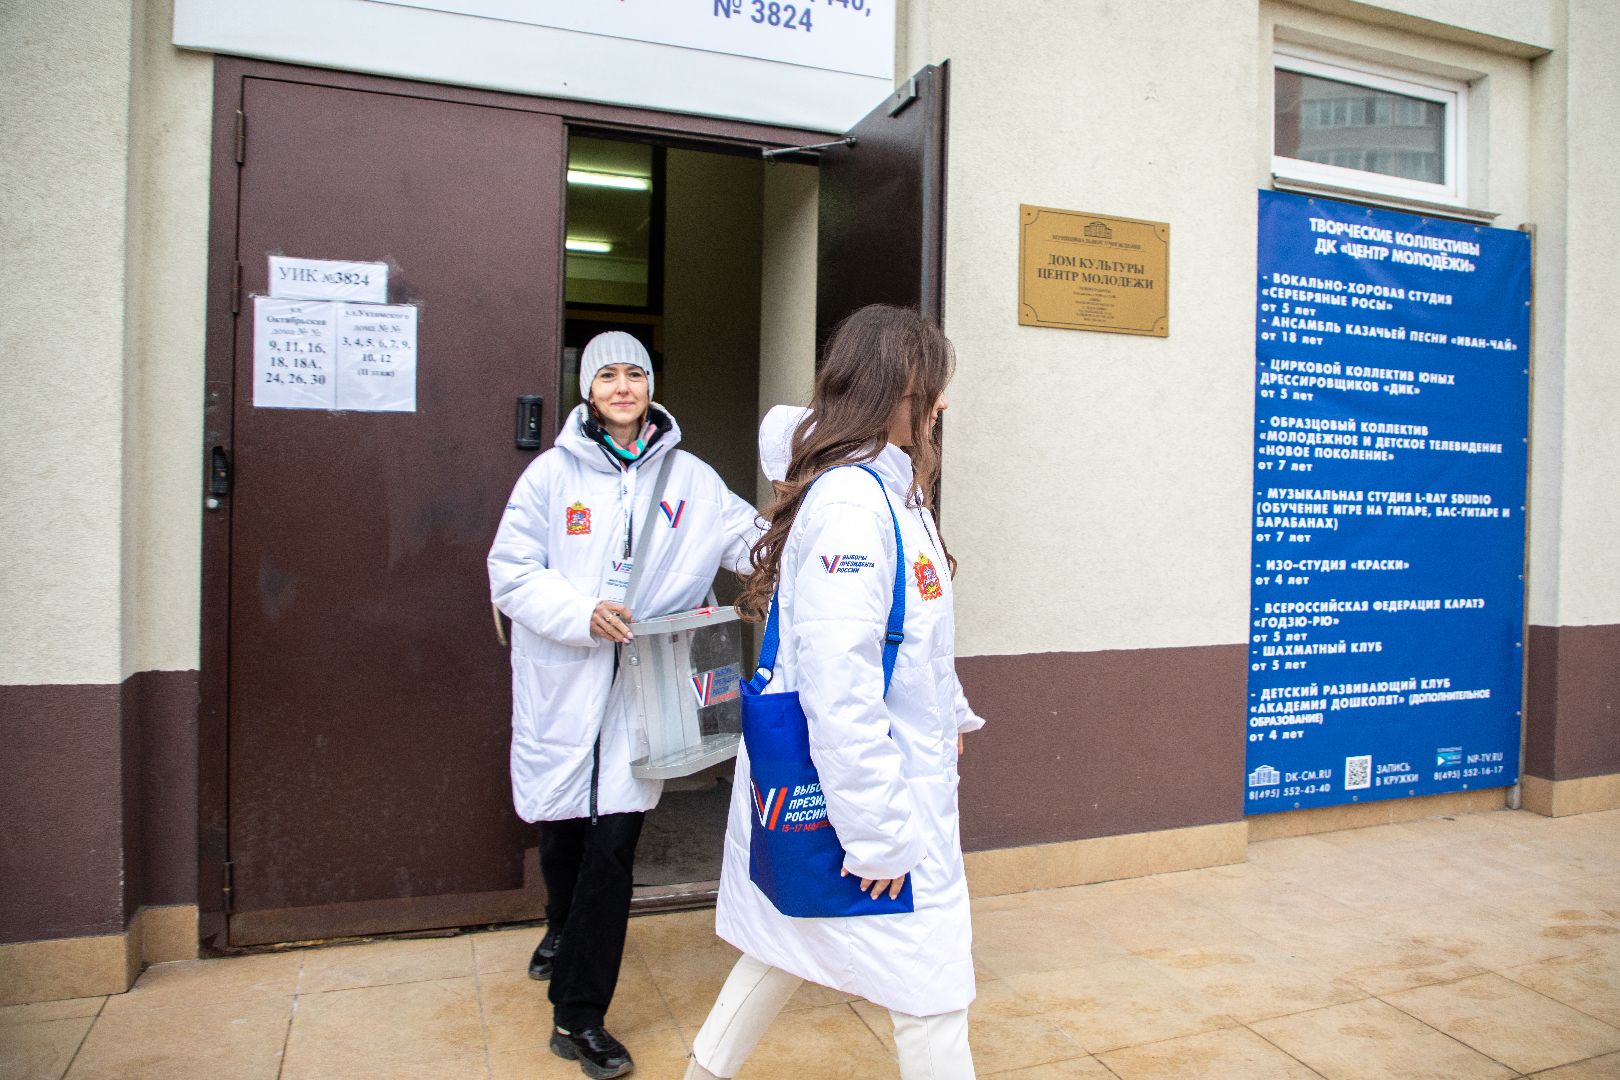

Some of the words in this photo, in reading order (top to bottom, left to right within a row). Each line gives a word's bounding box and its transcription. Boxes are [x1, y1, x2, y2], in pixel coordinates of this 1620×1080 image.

[713, 0, 742, 18] №
[750, 0, 813, 32] 3824
[1309, 217, 1394, 243] ТВОРЧЕСКИЕ
[1395, 231, 1480, 256] КОЛЛЕКТИВЫ
[1314, 238, 1337, 255] ДК
[1340, 242, 1389, 260] «ЦЕНТР
[1392, 250, 1476, 272] МОЛОДЁЖИ»
[1048, 254, 1076, 267] ДОМ
[1080, 257, 1144, 275] КУЛЬТУРЫ
[279, 266, 318, 282] УИК
[1037, 267, 1079, 282] ЦЕНТР
[1081, 272, 1154, 290] МОЛОДЕЖИ
[1272, 272, 1405, 300] ВОКАЛЬНО-ХОРОВАЯ
[1408, 290, 1452, 306] СТУДИЯ
[1262, 286, 1347, 306] «СЕРЕБРЯНЫЕ
[1352, 296, 1393, 310] РОСЫ»
[1261, 303, 1277, 312] от
[1282, 302, 1290, 314] 5
[1294, 306, 1316, 316] лет
[1261, 332, 1276, 341] от
[1282, 331, 1297, 343] 18
[1302, 336, 1323, 345] лет
[1271, 316, 1341, 333] АНСАМБЛЬ
[1346, 323, 1406, 340] КАЗАЧЬЕЙ
[1409, 330, 1447, 344] ПЕСНИ
[1451, 335, 1517, 351] «ИВАН-ЧАЙ»
[381, 354, 391, 362] 12
[1270, 358, 1341, 375] ЦИРКОВОЙ
[1345, 365, 1414, 382] КОЛЛЕКТИВ
[1419, 372, 1455, 385] ЮНЫХ
[311, 374, 326, 385] 30
[1260, 372, 1379, 392] ДРЕССИРОВЩИКОВ
[1383, 383, 1421, 395] «ДИК»
[1260, 389, 1275, 398] от
[1280, 388, 1288, 399] 5
[1292, 391, 1314, 401] лет
[1270, 416, 1356, 432] ОБРАЗЦОВЫЙ
[1361, 422, 1428, 436] КОЛЛЕКТИВ
[1259, 430, 1358, 446] «МОЛОДЕЖНОЕ
[1363, 435, 1371, 446] И
[1375, 436, 1425, 449] ДЕТСКОЕ
[1429, 439, 1503, 454] ТЕЛЕВИДЕНИЕ
[1258, 446, 1310, 458] «НОВОЕ
[1315, 447, 1394, 461] ПОКОЛЕНИЕ»
[1258, 461, 1273, 470] от
[1278, 459, 1286, 470] 7
[1291, 462, 1313, 472] лет
[1267, 488, 1363, 501] МУЗЫКАЛЬНАЯ
[1368, 491, 1412, 504] СТУДИЯ
[1415, 492, 1447, 504] L-RAY
[1256, 502, 1329, 515] (ОБУЧЕНИЕ
[1333, 504, 1363, 515] ИГРЕ
[1367, 505, 1383, 516] НА
[1387, 505, 1431, 518] ГИТАРЕ,
[1436, 506, 1499, 518] БАС-ГИТАРЕ
[1502, 508, 1510, 518] И
[1256, 517, 1339, 531] БАРАБАНАХ)
[1256, 533, 1271, 542] от
[1276, 532, 1284, 542] 7
[1289, 534, 1311, 542] лет
[839, 560, 875, 568] ПРЕЗИДЕНТА
[1266, 559, 1347, 572] ИЗО-СТУДИЯ
[1351, 559, 1410, 570] «КРАСКИ»
[1255, 577, 1270, 585] от
[1274, 574, 1283, 585] 4
[1287, 577, 1309, 585] лет
[1264, 598, 1369, 614] ВСЕРОССИЙСКАЯ
[1373, 599, 1441, 612] ФЕДЕРАЦИЯ
[1444, 598, 1485, 609] КАРАТЭ
[1254, 615, 1339, 629] «ГОДЗЮ-РЮ»
[1253, 634, 1268, 642] от
[1273, 631, 1280, 642] 5
[1286, 632, 1307, 641] лет
[1262, 640, 1346, 656] ШАХМАТНЫЙ
[1350, 641, 1382, 653] КЛУБ
[1251, 662, 1267, 671] от
[1272, 660, 1279, 671] 5
[1284, 661, 1307, 670] лет
[1260, 683, 1318, 701] ДЕТСКИЙ
[1323, 677, 1417, 695] РАЗВИВАЮЩИЙ
[1421, 678, 1450, 689] КЛУБ
[1250, 699, 1327, 714] «АКАДЕМИЯ
[1331, 694, 1405, 711] ДОШКОЛЯТ»
[1409, 689, 1491, 706] (ДОПОЛНИТЕЛЬНОЕ
[1249, 713, 1323, 727] ОБРАЗОВАНИЕ)
[1249, 733, 1264, 742] от
[1269, 730, 1277, 740] 4
[1282, 730, 1304, 739] лет
[1467, 752, 1504, 764] NP-TV.RU
[1376, 762, 1411, 774] ЗАПИСЬ
[1462, 765, 1504, 778] 552-16-17
[1284, 769, 1332, 783] DK-CM.RU
[1375, 777, 1381, 787] В
[1383, 774, 1419, 785] КРУЖКИ
[793, 783, 821, 797] ВЫБО
[1283, 783, 1331, 797] 552-43-40
[788, 795, 827, 810] ПРЕЗИ
[784, 808, 827, 822] РОССИИ
